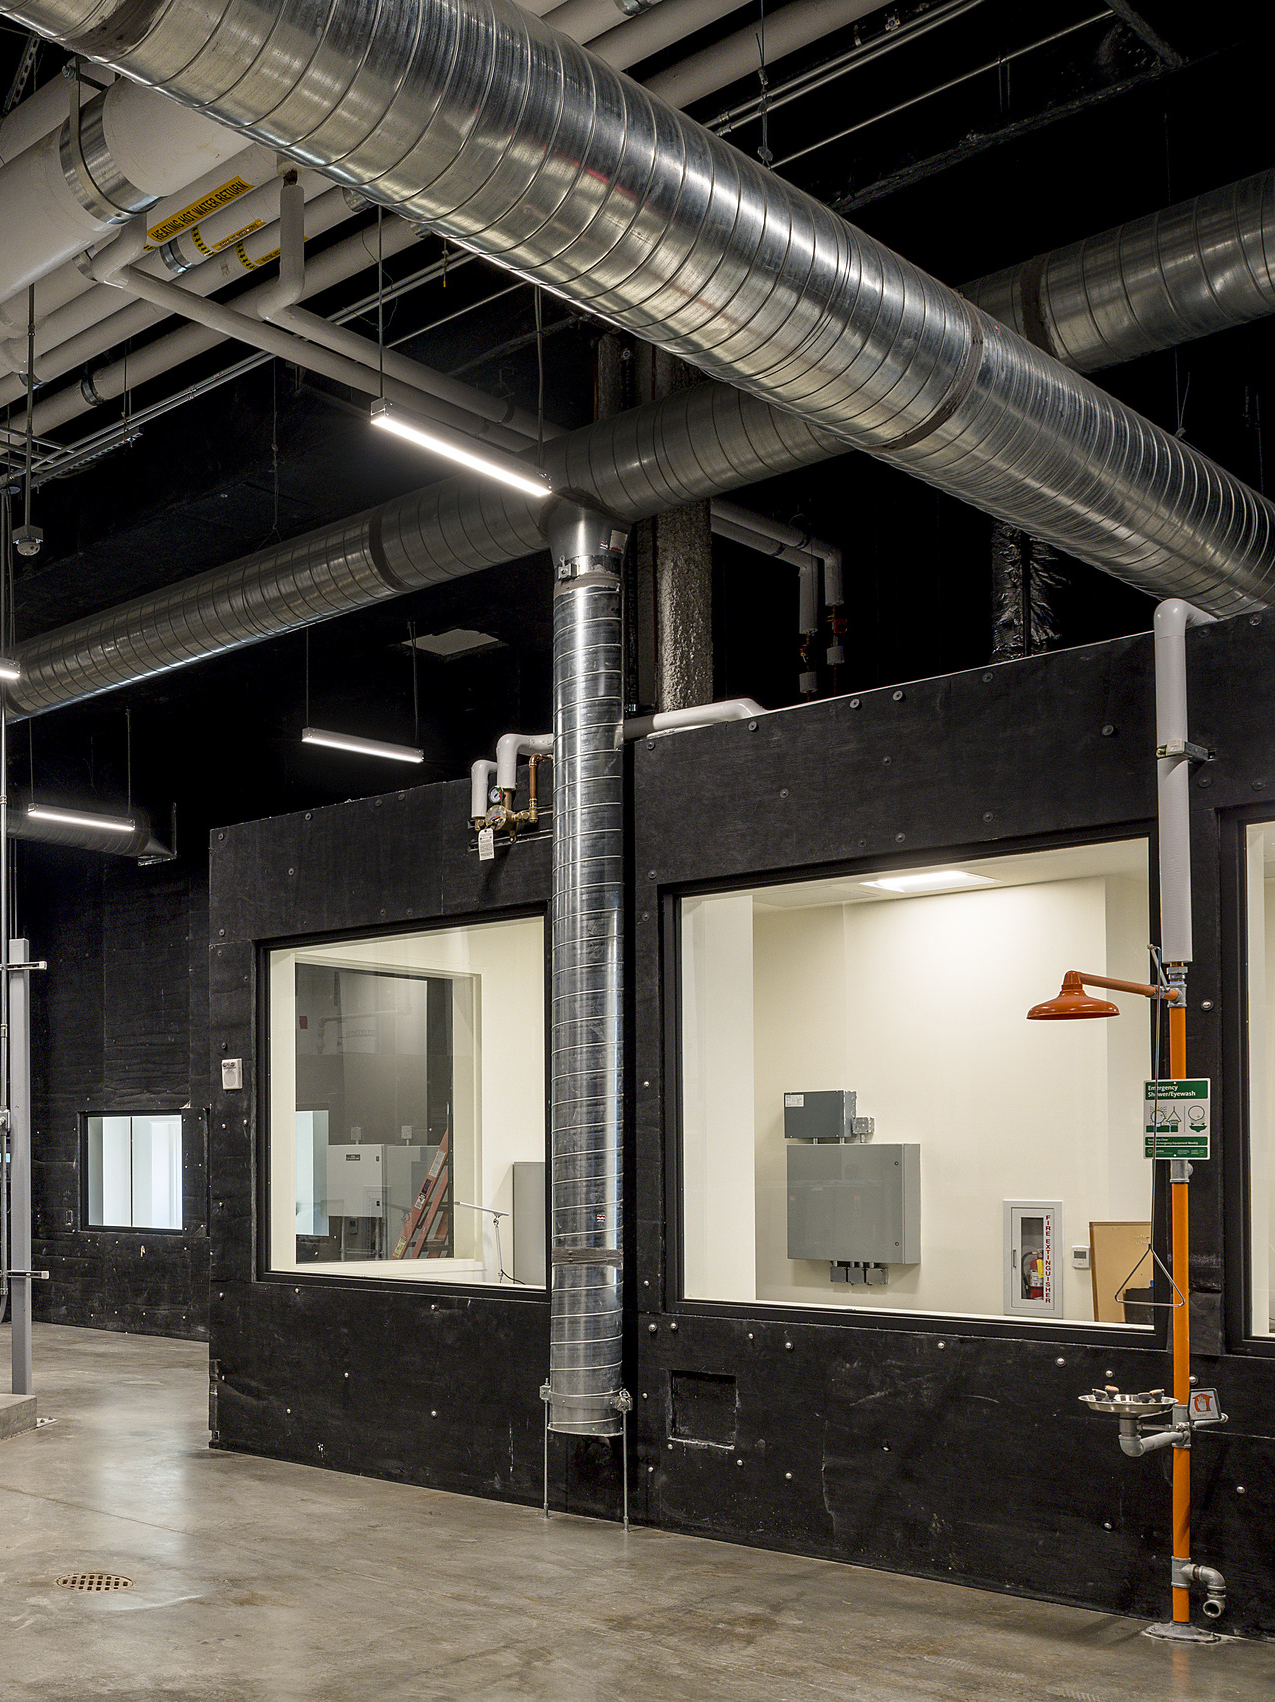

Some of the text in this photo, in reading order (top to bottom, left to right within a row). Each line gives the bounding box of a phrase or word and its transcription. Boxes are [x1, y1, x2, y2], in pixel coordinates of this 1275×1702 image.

[151, 217, 184, 241] HEATING
[178, 210, 198, 225] HOT
[192, 197, 220, 217] WATER
[215, 180, 248, 203] RETURN
